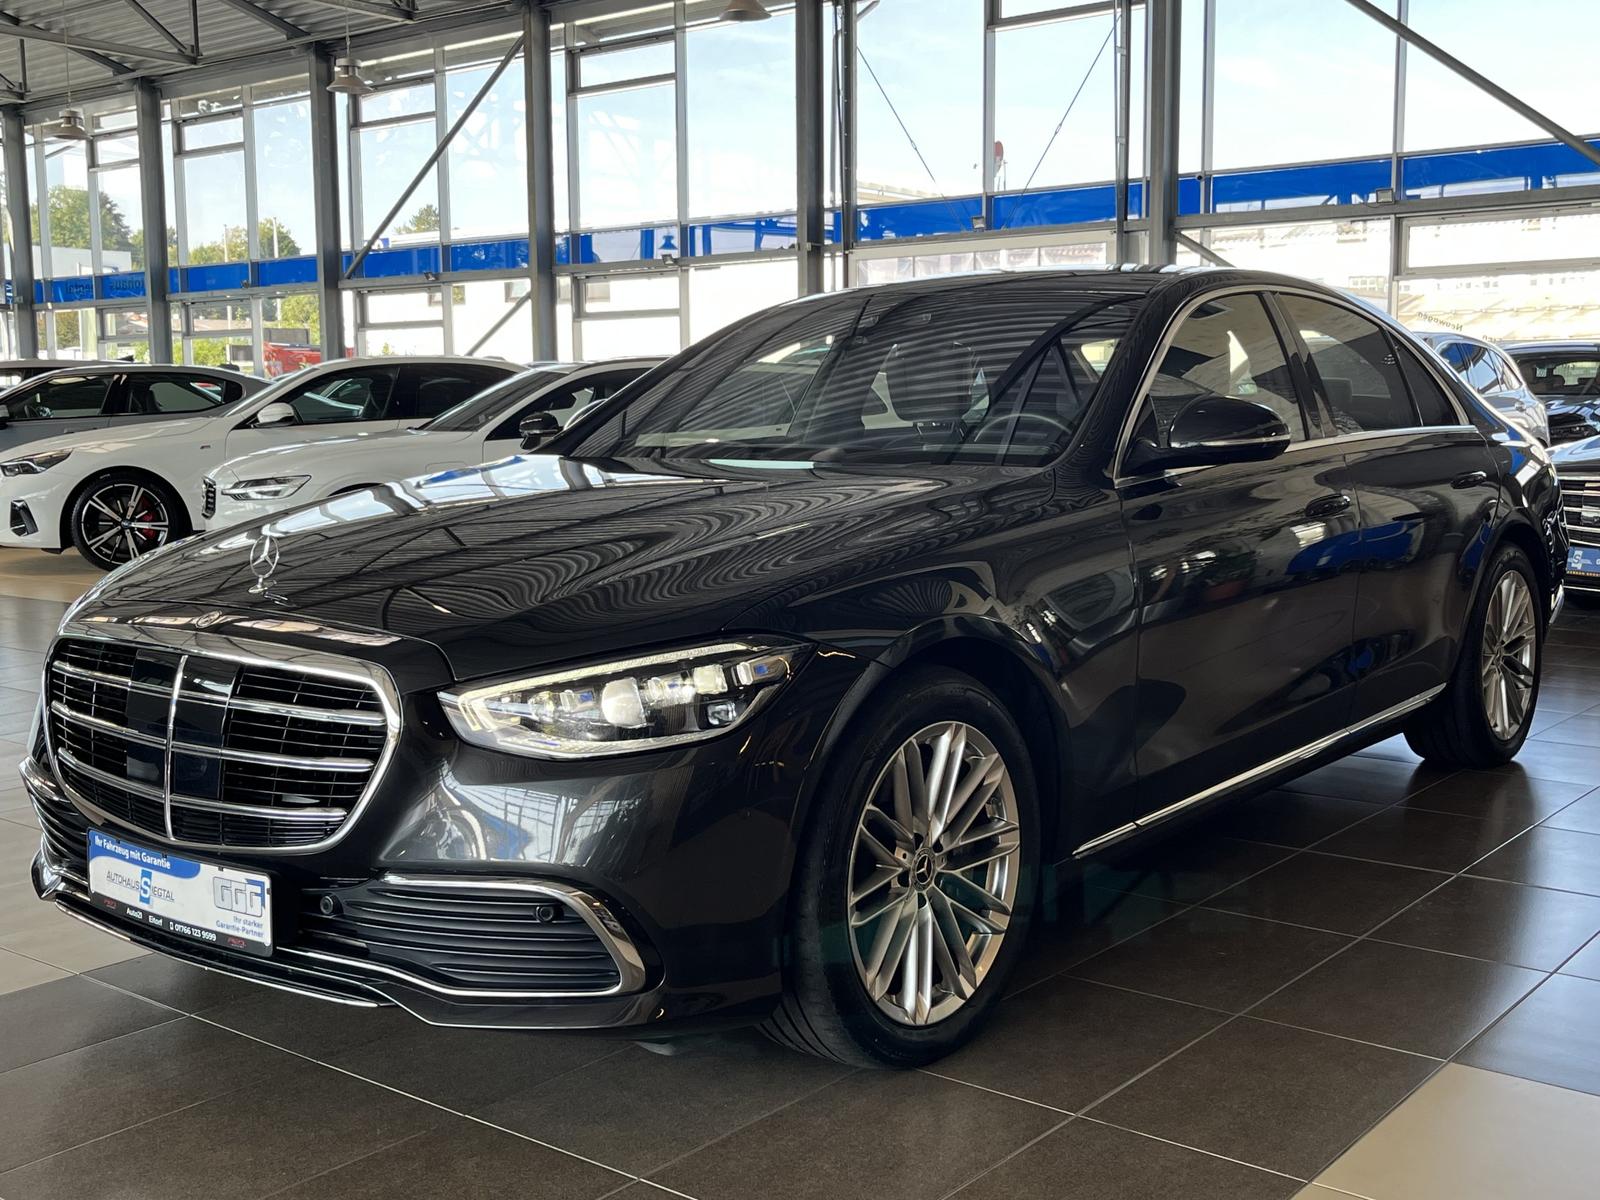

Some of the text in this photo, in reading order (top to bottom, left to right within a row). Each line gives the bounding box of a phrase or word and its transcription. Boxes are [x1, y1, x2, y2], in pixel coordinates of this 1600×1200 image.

[103, 839, 130, 859] Fahrzeug
[130, 850, 141, 861] mit
[141, 853, 171, 869] Garantie
[106, 870, 140, 890] AUTOHAUS
[215, 920, 264, 938] Garantie-Partner
[242, 918, 263, 929] starker
